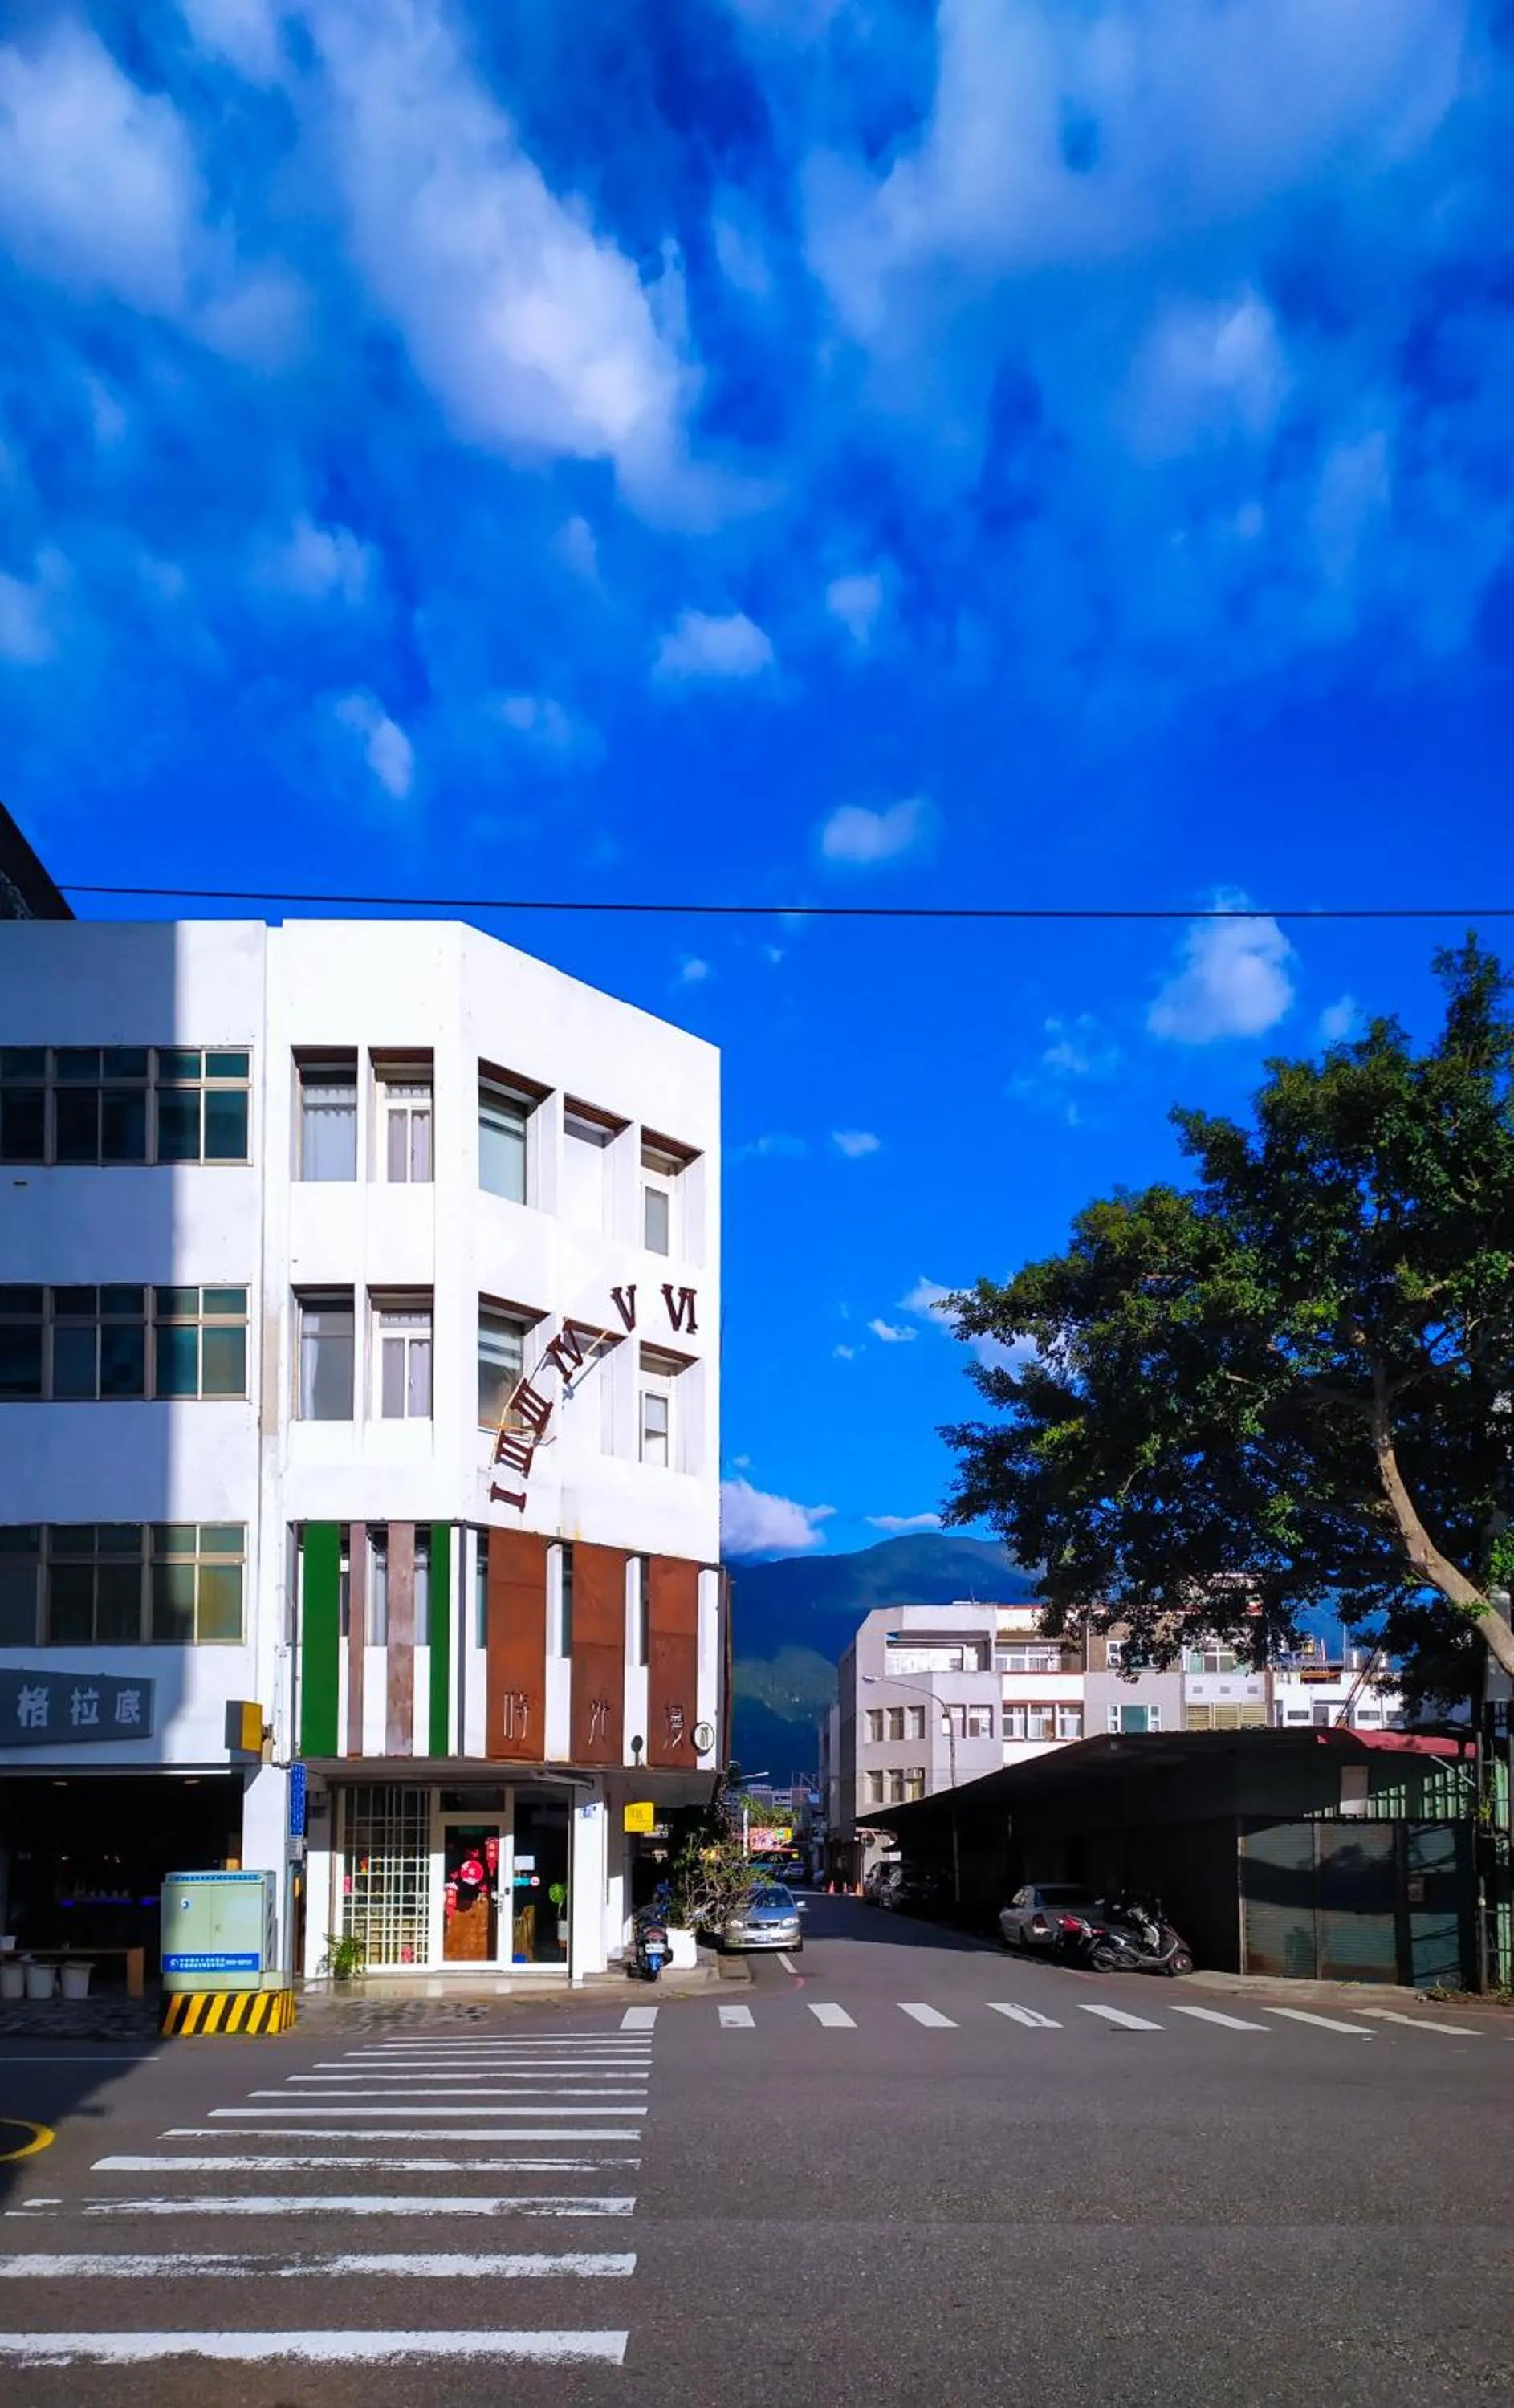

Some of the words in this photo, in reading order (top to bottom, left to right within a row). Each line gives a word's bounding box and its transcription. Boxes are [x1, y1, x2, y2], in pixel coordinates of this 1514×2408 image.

[610, 1283, 637, 1333] V
[661, 1283, 699, 1336] VI
[17, 1684, 141, 1728] 格拉底
